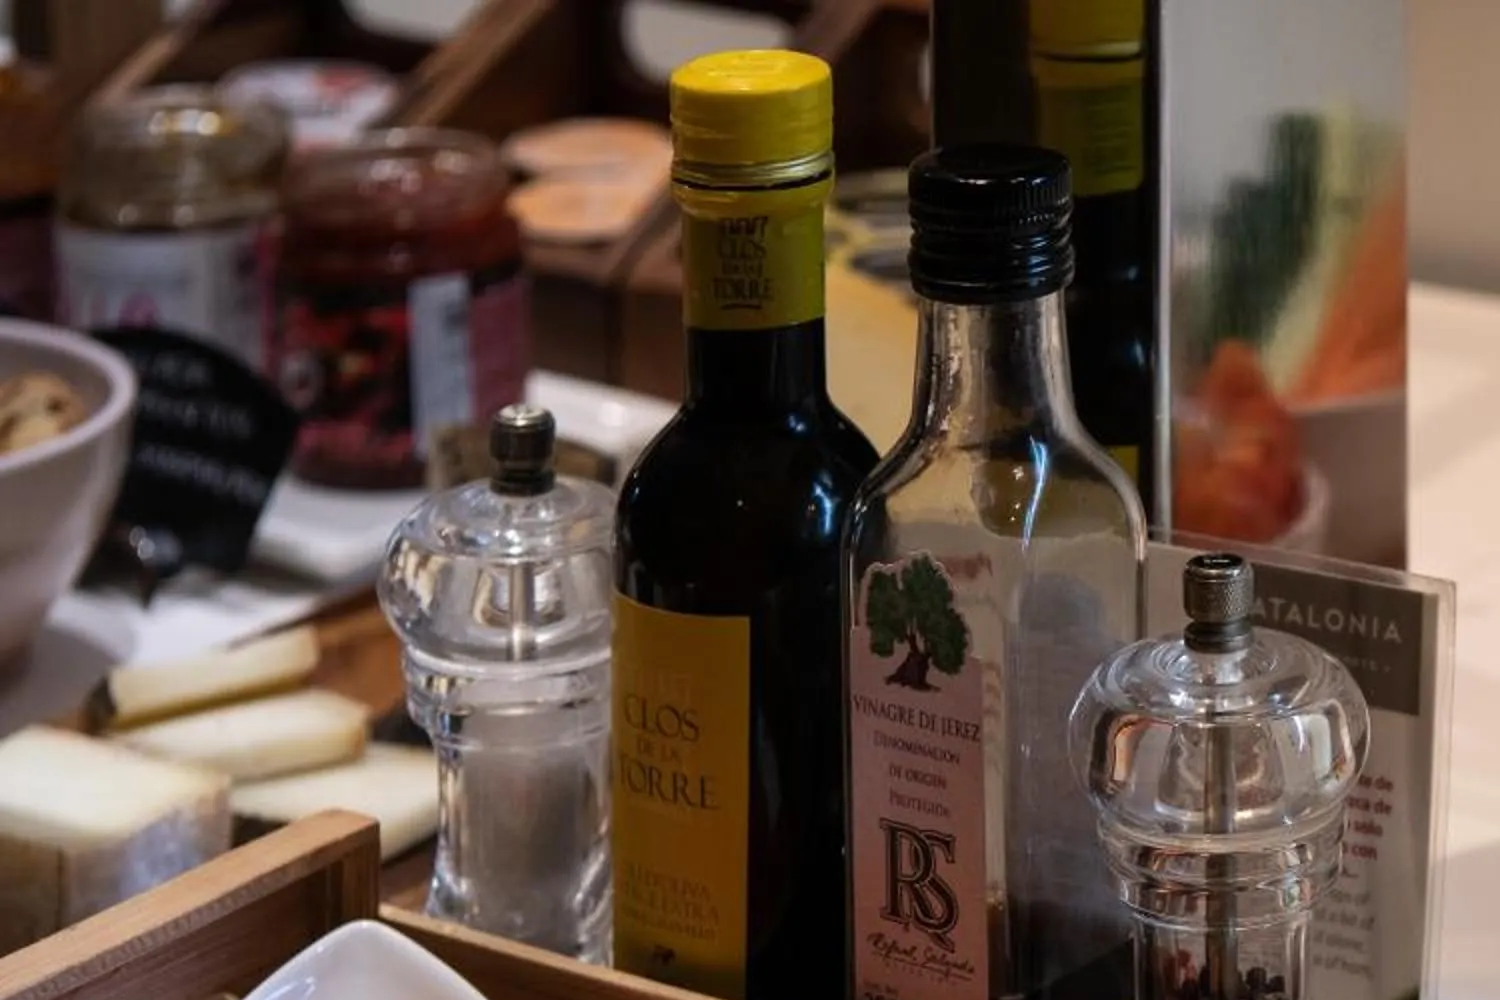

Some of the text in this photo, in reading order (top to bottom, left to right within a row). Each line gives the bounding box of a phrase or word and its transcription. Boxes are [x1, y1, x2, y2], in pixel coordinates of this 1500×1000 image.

[1250, 597, 1402, 644] ATALONIA
[624, 690, 700, 743] CLOS
[853, 694, 980, 742] VINAGRE DE JEREZ
[620, 753, 722, 812] TORRE
[879, 817, 960, 953] RS
